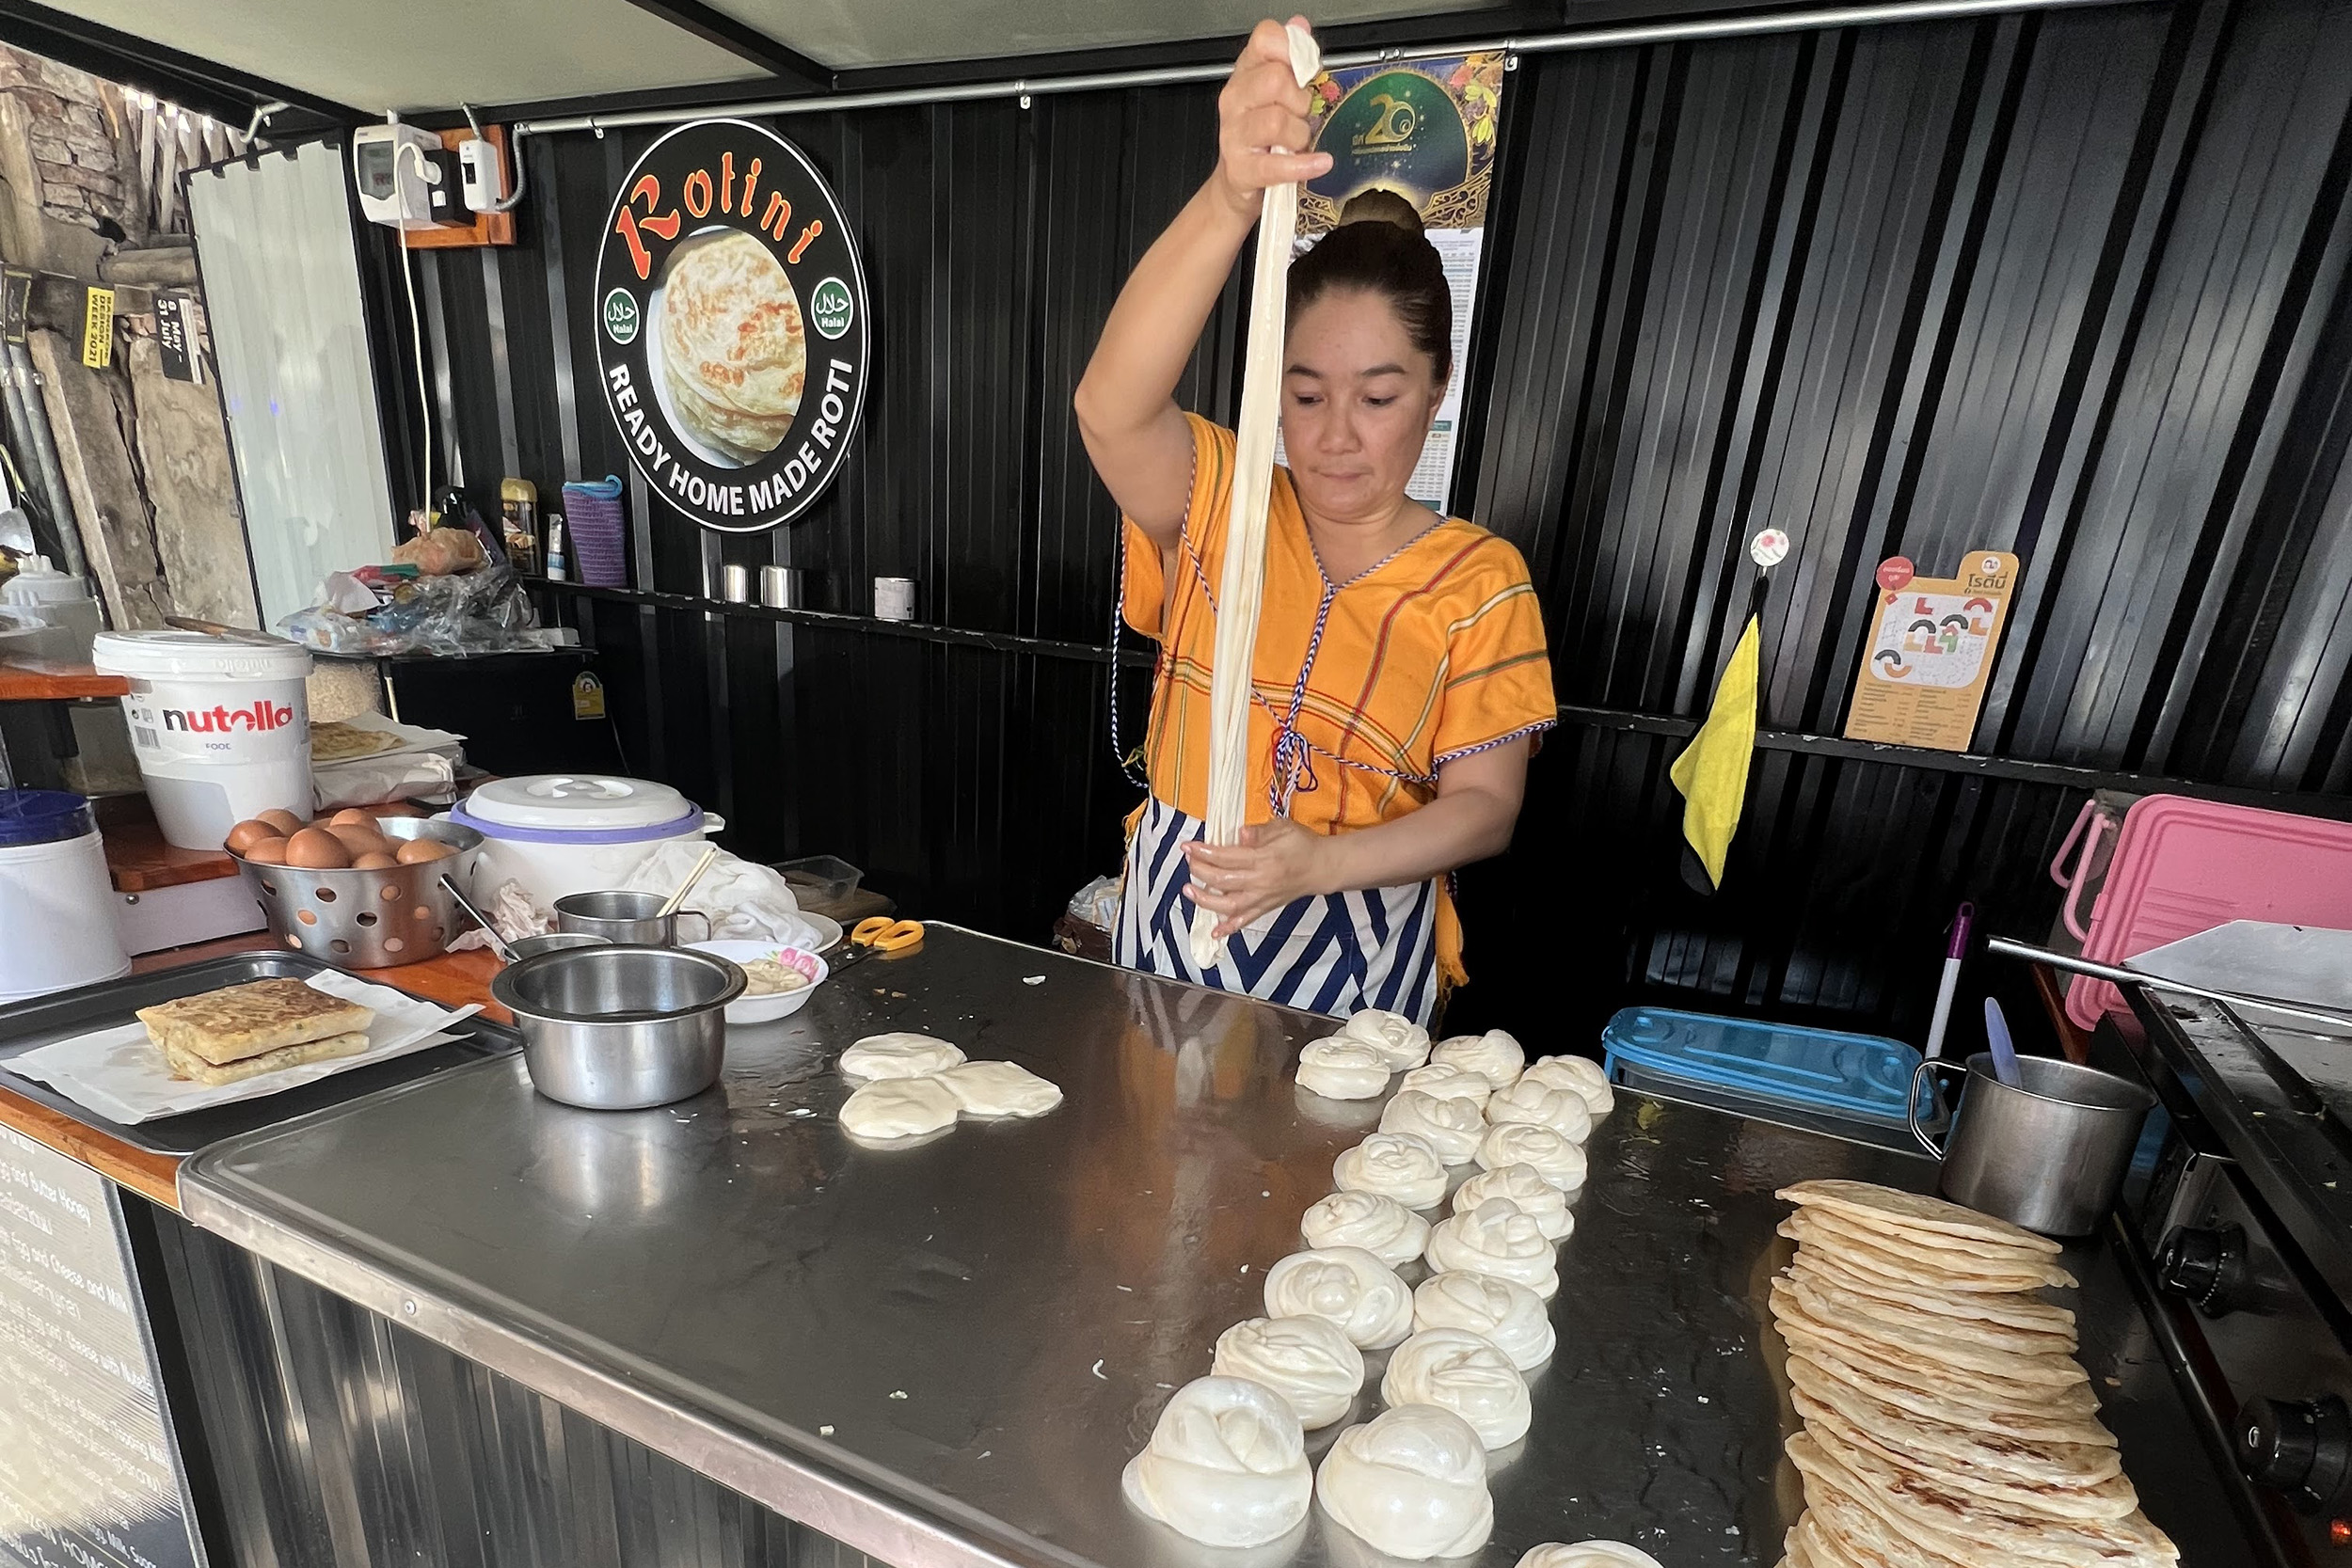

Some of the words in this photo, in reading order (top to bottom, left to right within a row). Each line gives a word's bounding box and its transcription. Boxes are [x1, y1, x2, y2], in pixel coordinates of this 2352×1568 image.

[616, 151, 823, 279] Rotini
[157, 299, 169, 316] 31
[608, 302, 635, 322] حلال
[815, 293, 849, 315] حلال
[161, 319, 173, 349] July
[612, 324, 633, 334] Halal
[821, 316, 845, 328] Halal
[88, 332, 98, 362] 2021
[171, 321, 183, 353] May
[609, 363, 672, 472] READY
[669, 462, 745, 515] HOME
[748, 441, 823, 515] MADE
[810, 358, 853, 451] ROTI
